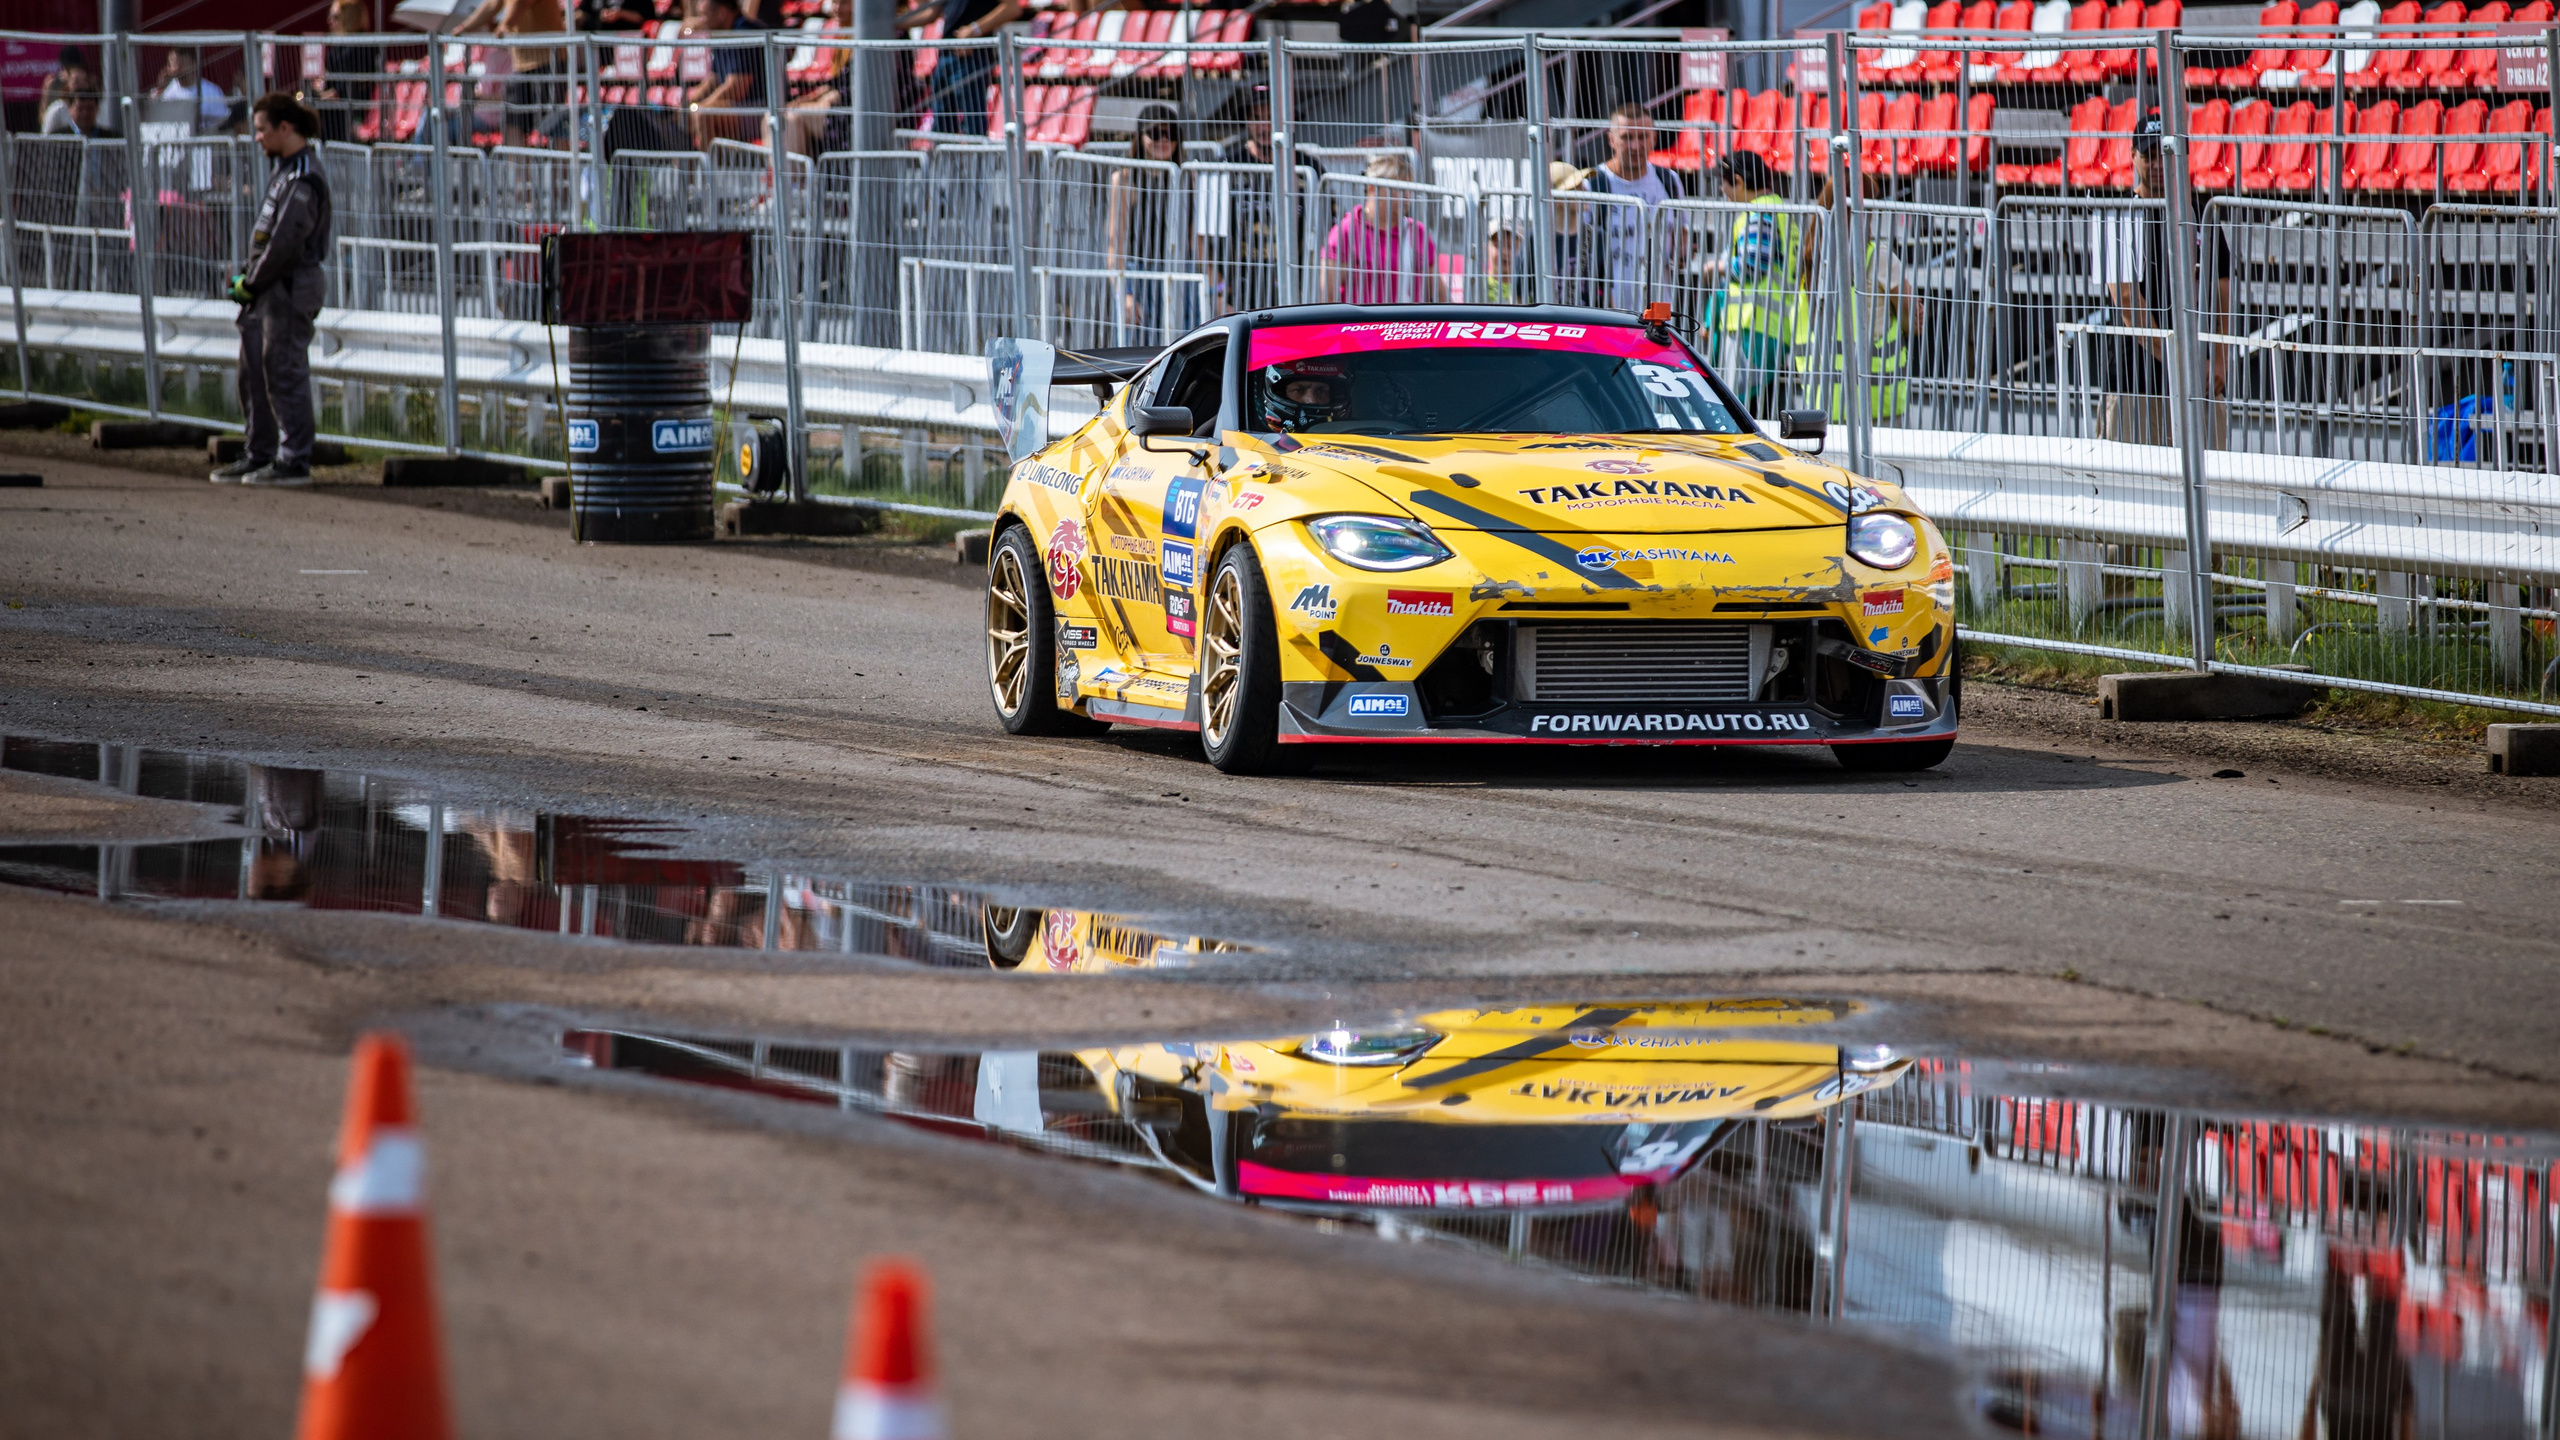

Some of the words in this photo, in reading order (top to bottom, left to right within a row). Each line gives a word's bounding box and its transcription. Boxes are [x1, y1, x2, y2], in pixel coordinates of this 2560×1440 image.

[2506, 67, 2536, 86] ТРИБУНА
[1341, 322, 1438, 333] РОССИЙСКАЯ
[1380, 327, 1436, 337] ДРИФТ
[1383, 332, 1433, 341] СЕРИЯ
[1446, 321, 1555, 341] RDS
[1631, 364, 1725, 406] 31
[1028, 463, 1083, 495] LINGLONG
[1518, 478, 1757, 504] TAKAYAMA
[1173, 489, 1199, 525] ВТБ
[1566, 497, 1664, 511] МОТОРНЫЕ
[1668, 498, 1726, 510] МАСЛА
[1110, 534, 1138, 551] МОТОРНЫЕ
[1138, 537, 1156, 554] МАСЛА
[1164, 549, 1193, 577] AIMOL
[1619, 547, 1737, 565] KASHIYAMA
[1091, 555, 1162, 605] TAKAYAMA
[1309, 610, 1337, 620] POINT
[1062, 629, 1096, 640] VISSOL
[1357, 655, 1412, 667] JONNESWAY
[1351, 698, 1406, 713] AIMOL
[1892, 699, 1923, 713] AIMOL
[1530, 713, 1810, 732] FORWARDAUTO.RU
